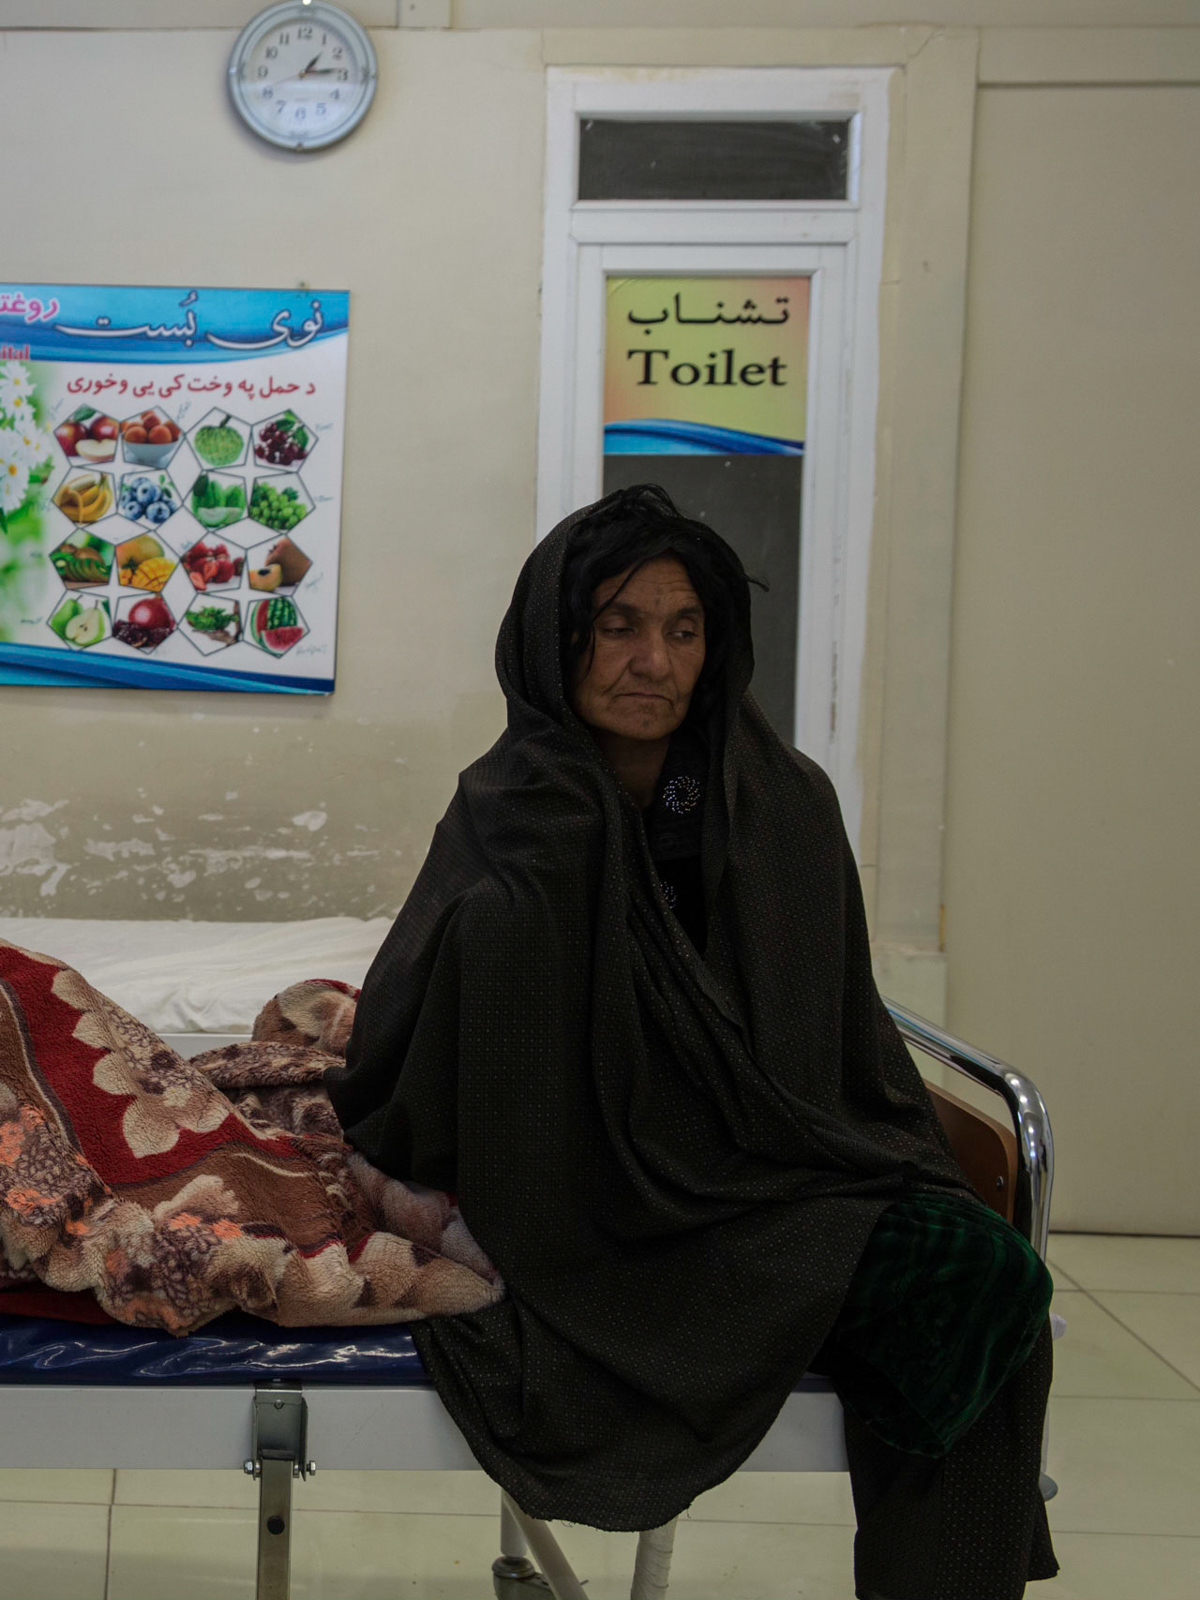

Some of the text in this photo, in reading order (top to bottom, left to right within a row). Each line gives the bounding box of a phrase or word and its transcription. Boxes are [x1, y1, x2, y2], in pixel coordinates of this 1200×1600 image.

[279, 32, 290, 45] 11
[297, 27, 313, 40] 12
[321, 33, 327, 46] 1
[265, 45, 278, 59] 10
[332, 46, 343, 60] 2
[257, 65, 269, 78] 9
[337, 68, 349, 82] 3
[262, 86, 274, 99] 8
[329, 88, 340, 100] 4
[276, 99, 287, 114] 7
[295, 106, 306, 120] 6
[315, 102, 326, 115] 5
[627, 292, 789, 336] تشناب
[626, 347, 788, 387] Toilet
[237, 379, 255, 400] په
[259, 375, 301, 399] حمل
[305, 382, 317, 395] د
